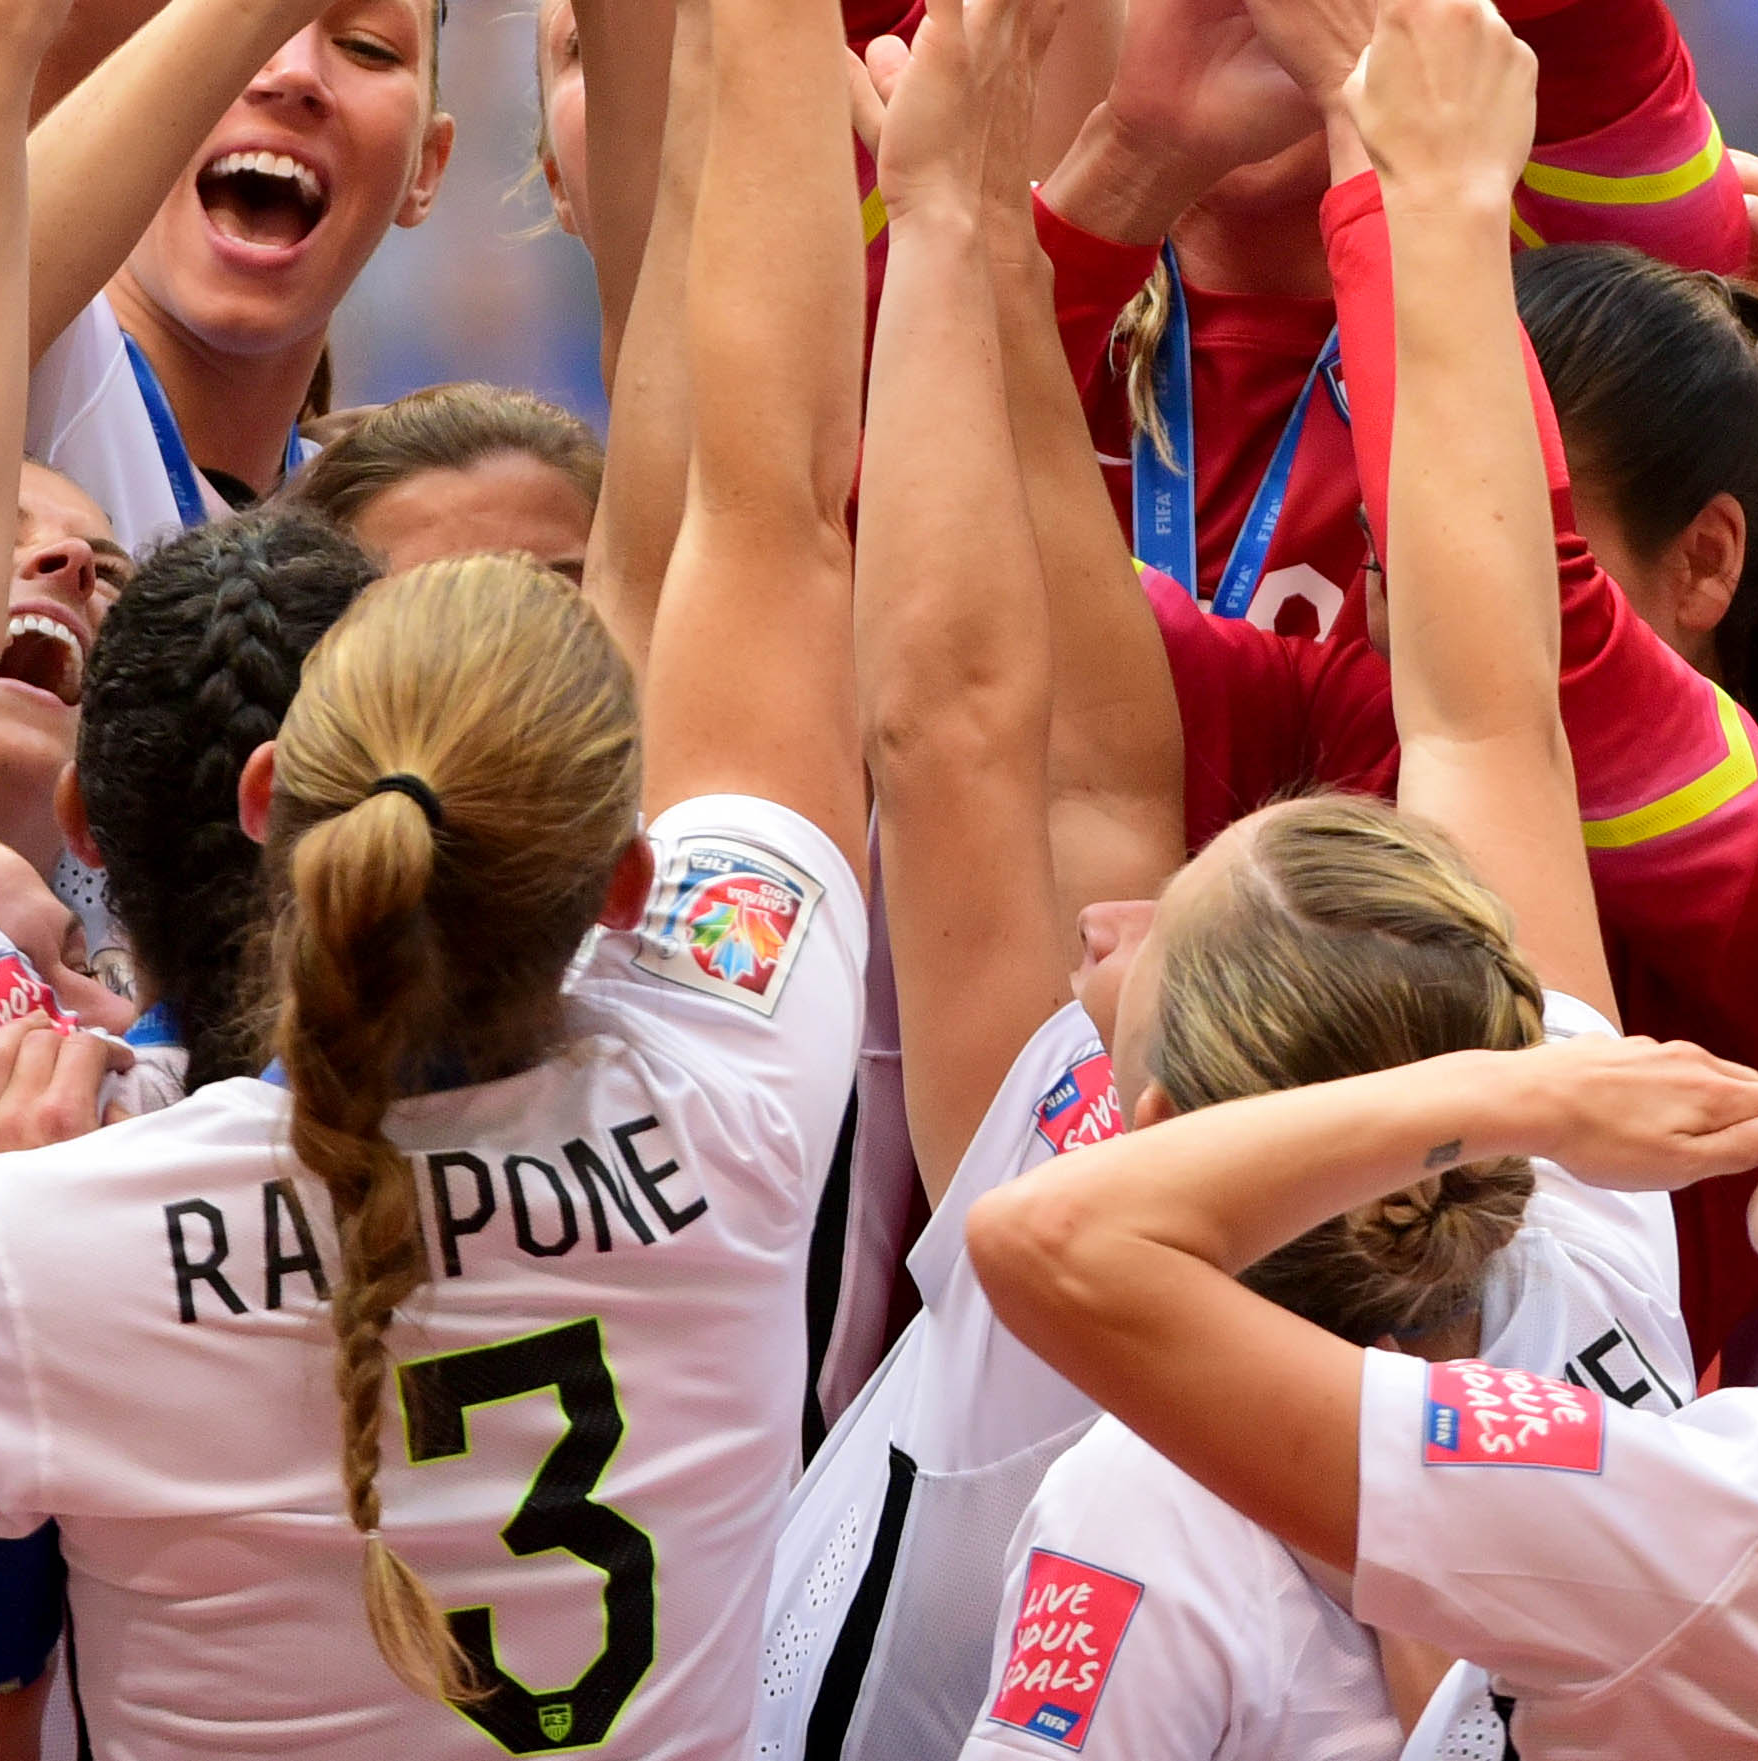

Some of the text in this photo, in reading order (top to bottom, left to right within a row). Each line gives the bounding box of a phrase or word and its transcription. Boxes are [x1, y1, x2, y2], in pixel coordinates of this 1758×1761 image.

[1156, 494, 1173, 535] FIFA
[1225, 565, 1251, 609] FIFA
[1043, 1082, 1076, 1113] FIFA
[1063, 1069, 1121, 1151] OALS
[164, 1114, 709, 1324] RAPONE
[1435, 1407, 1453, 1445] FIFA
[396, 1316, 660, 1756] 3
[1022, 1582, 1094, 1619] LIVE
[1035, 1710, 1072, 1733] FIFA
